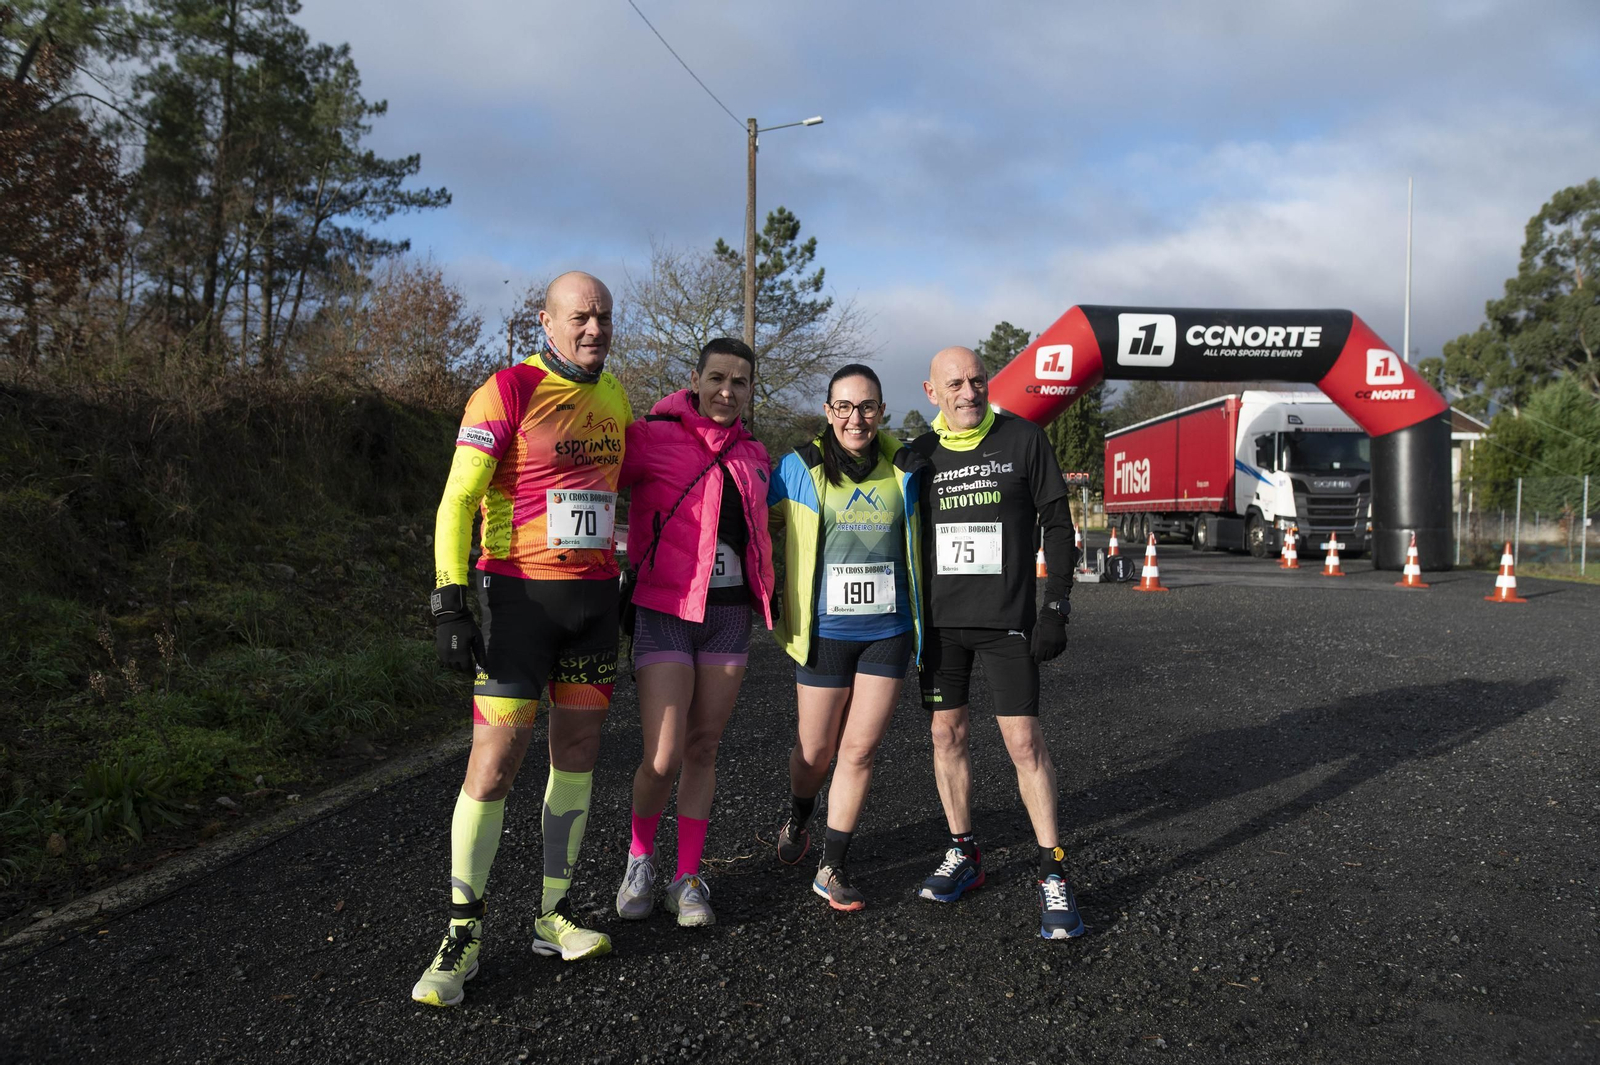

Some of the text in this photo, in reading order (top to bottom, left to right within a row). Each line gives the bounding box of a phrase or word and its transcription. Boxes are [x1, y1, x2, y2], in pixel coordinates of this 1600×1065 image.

[1185, 325, 1322, 347] CCNORTE
[1203, 349, 1303, 358] ALL FOR SPORTS EVENTS
[1025, 385, 1078, 395] CCNORTE
[1355, 389, 1416, 400] CCNORTE
[933, 460, 1014, 484] amargha
[1113, 451, 1151, 495] Finsa
[568, 492, 589, 502] CROSS
[939, 490, 1002, 511] AUTOTODO
[571, 510, 597, 536] 70
[940, 526, 951, 534] XXV
[952, 540, 975, 564] 75
[845, 566, 864, 575] CROSS
[843, 581, 875, 605] 190
